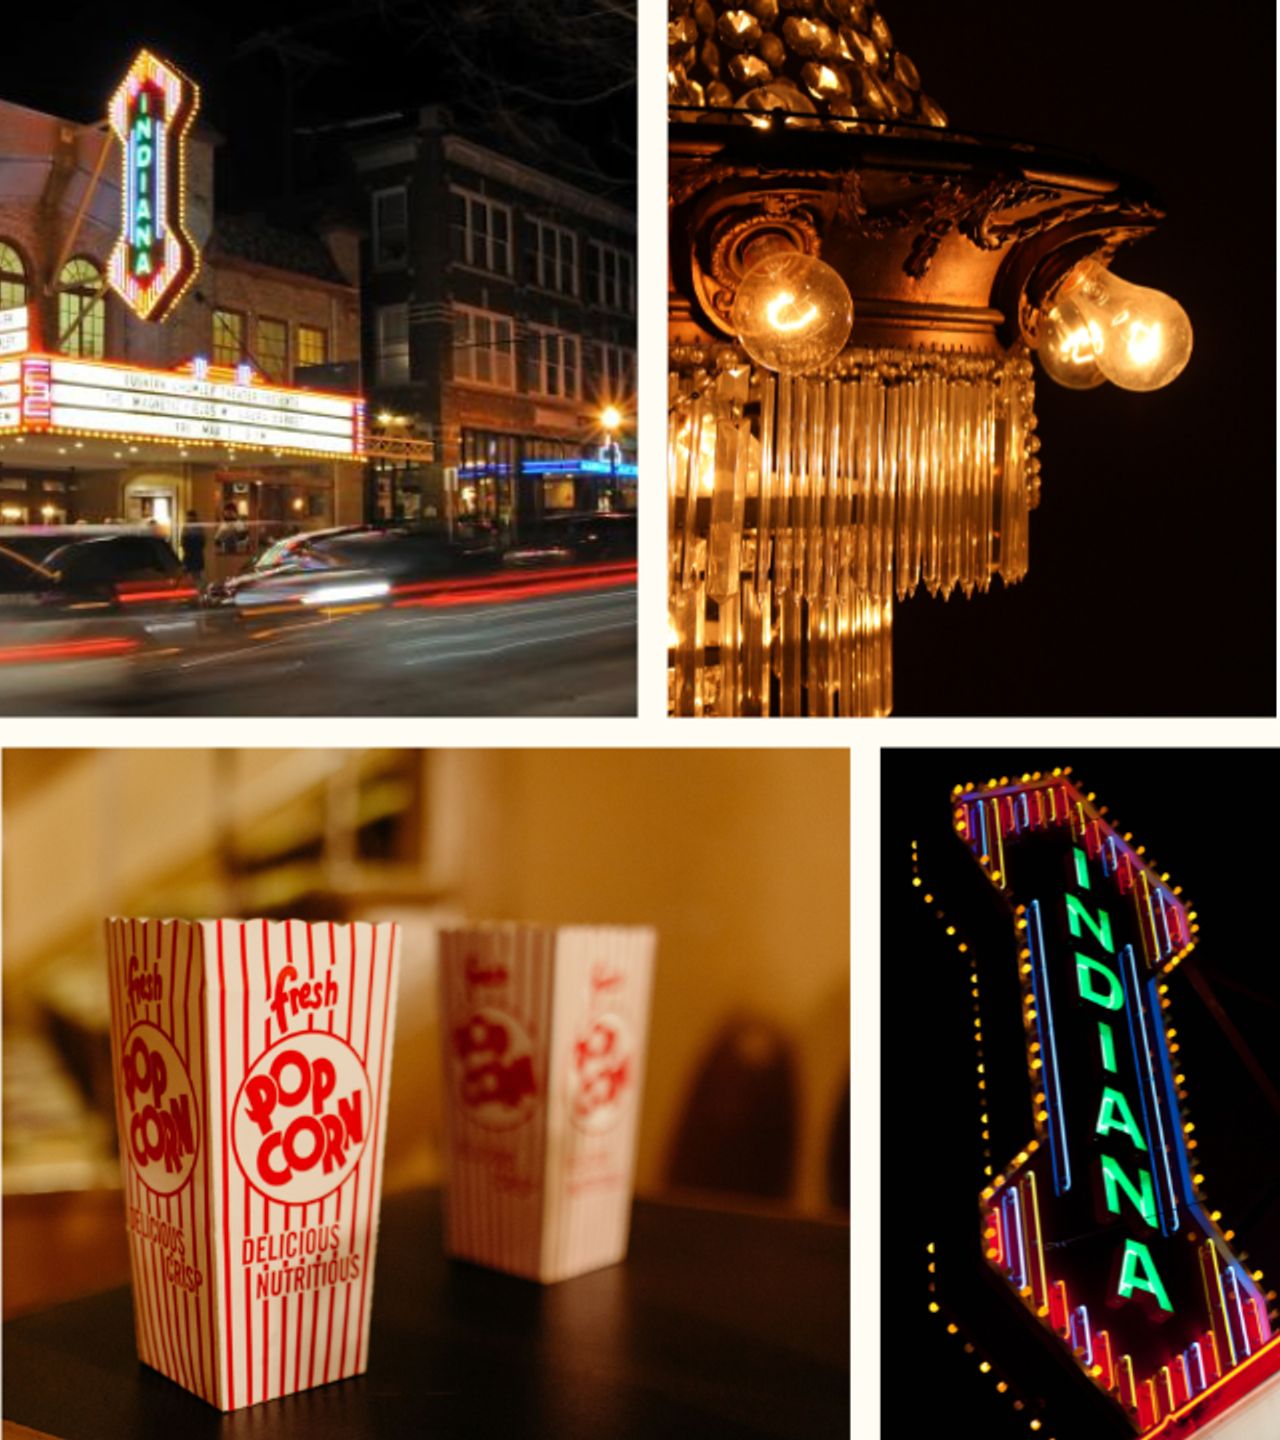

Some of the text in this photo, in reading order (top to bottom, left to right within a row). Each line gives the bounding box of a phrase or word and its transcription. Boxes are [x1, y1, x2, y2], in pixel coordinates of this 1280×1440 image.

[135, 92, 153, 275] INDIANA
[127, 955, 164, 1011] fresh
[270, 964, 339, 1035] fresh
[123, 1036, 168, 1112] POP
[245, 1050, 337, 1136] POP
[1065, 847, 1174, 1314] INDIANA
[130, 1094, 195, 1175] CORN
[256, 1089, 364, 1187] CORN
[129, 1206, 186, 1255] DELICIOUS
[242, 1224, 341, 1266] DELICIOUS
[166, 1252, 204, 1295] CRISP
[255, 1254, 362, 1300] NUTRITIOUS
